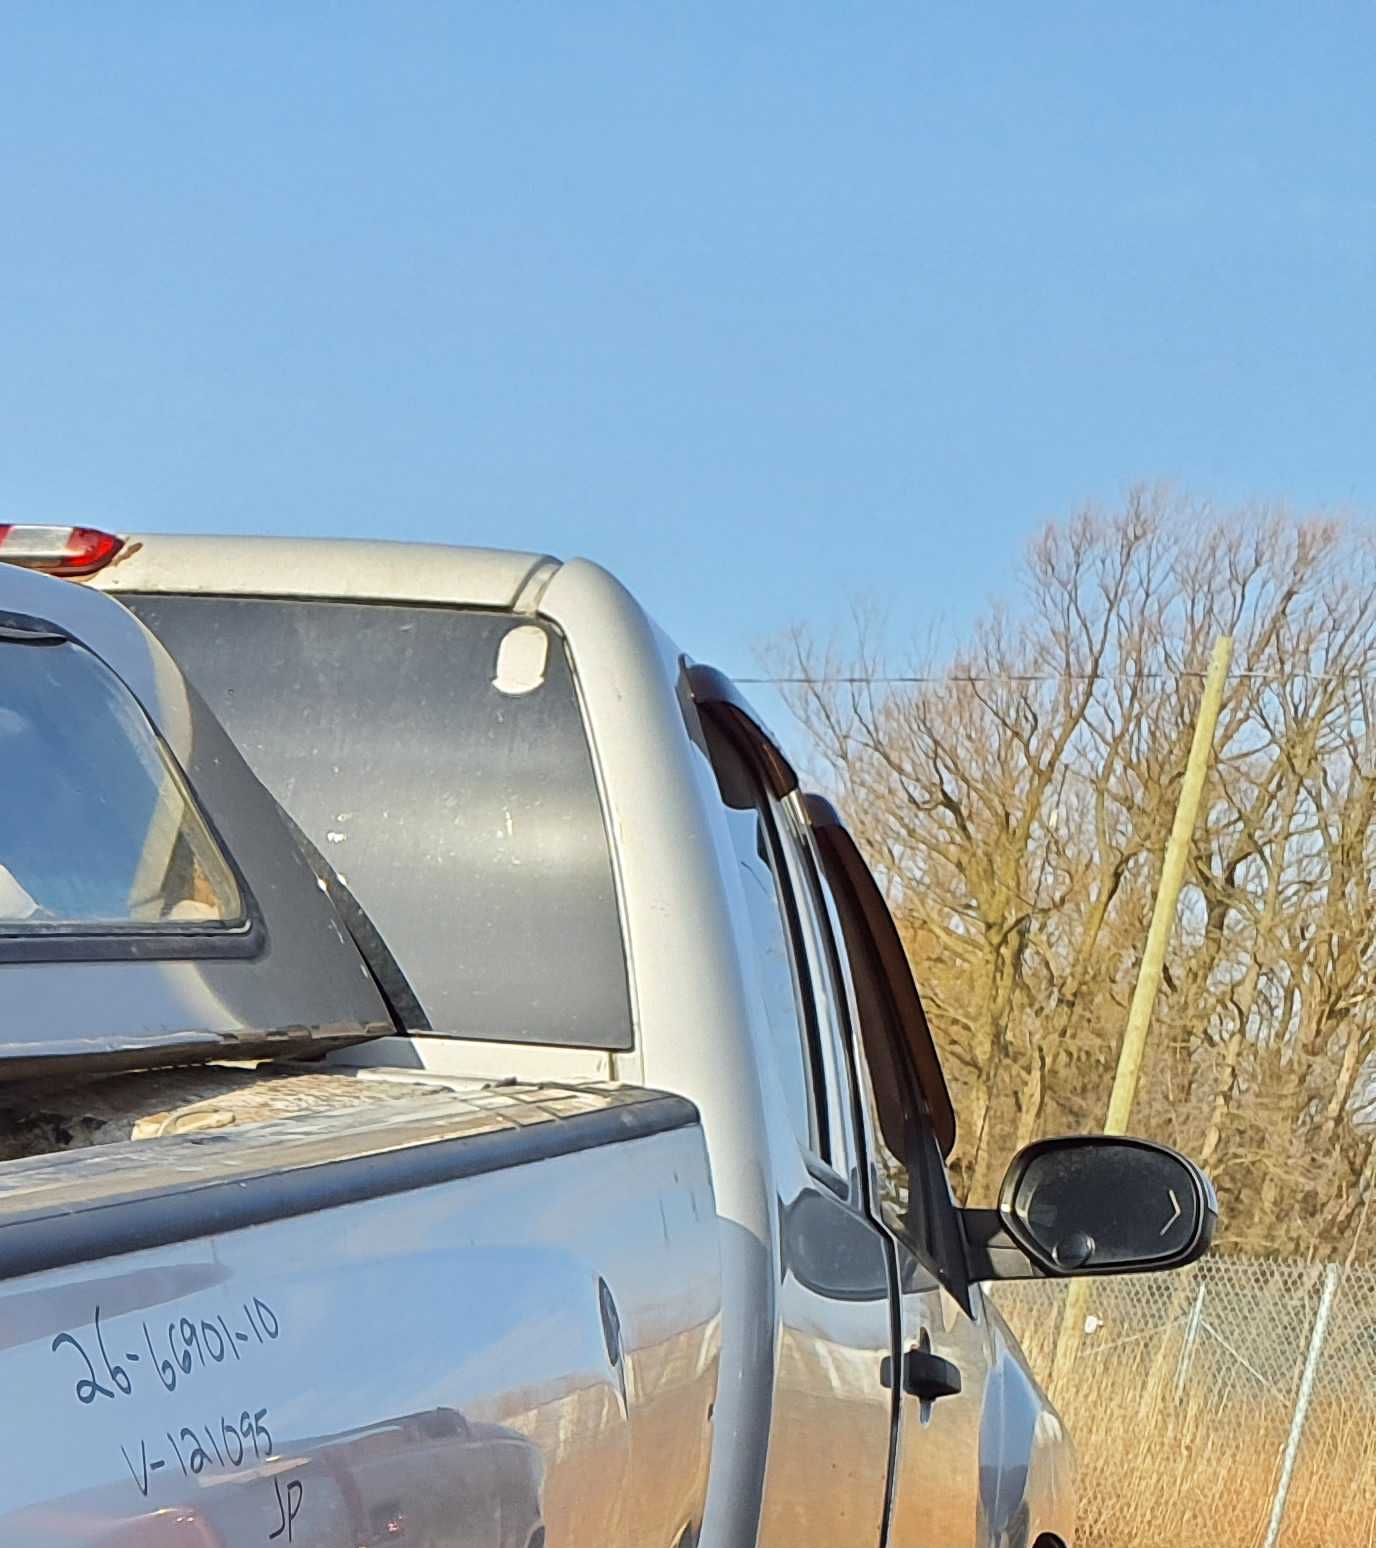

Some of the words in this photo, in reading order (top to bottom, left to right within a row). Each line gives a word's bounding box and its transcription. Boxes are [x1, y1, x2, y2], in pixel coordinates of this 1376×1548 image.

[52, 1297, 279, 1404] 26-66901-10
[121, 1408, 273, 1496] V-121095
[269, 1476, 304, 1543] JP
